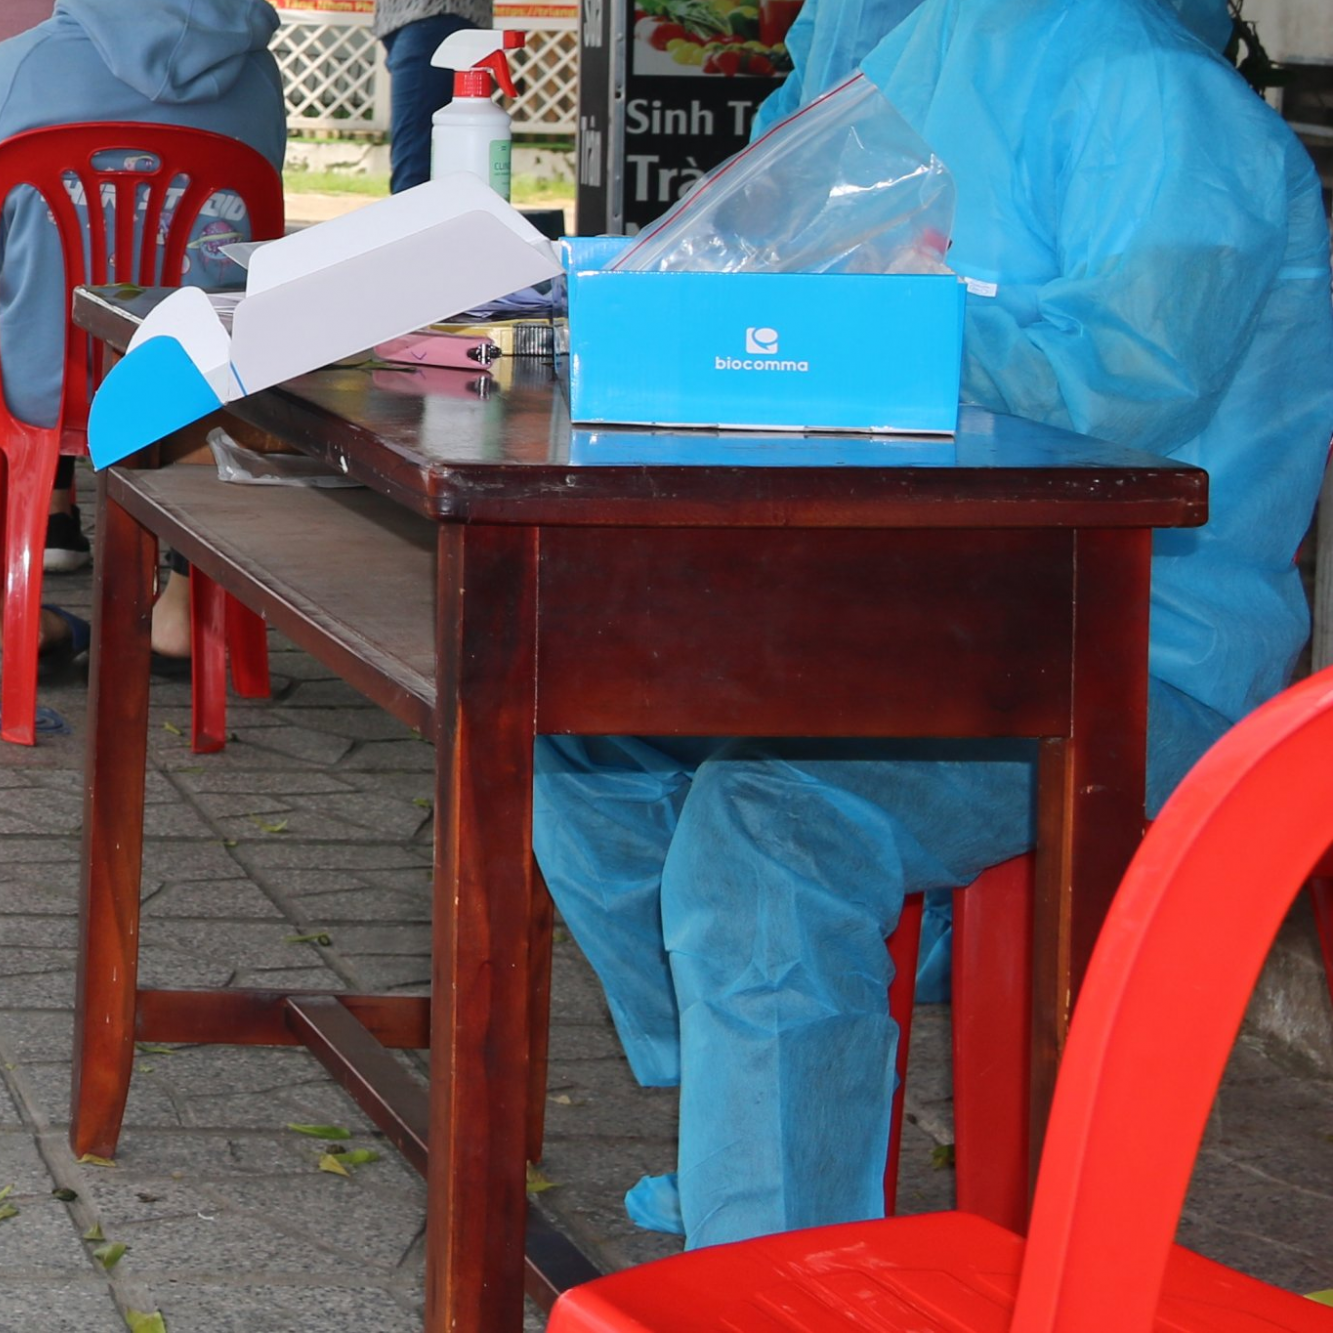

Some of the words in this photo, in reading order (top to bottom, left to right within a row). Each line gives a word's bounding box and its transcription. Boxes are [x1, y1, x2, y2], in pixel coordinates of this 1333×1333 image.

[626, 99, 714, 136] Sinh
[727, 100, 760, 136] T
[715, 356, 809, 372] biocomma
